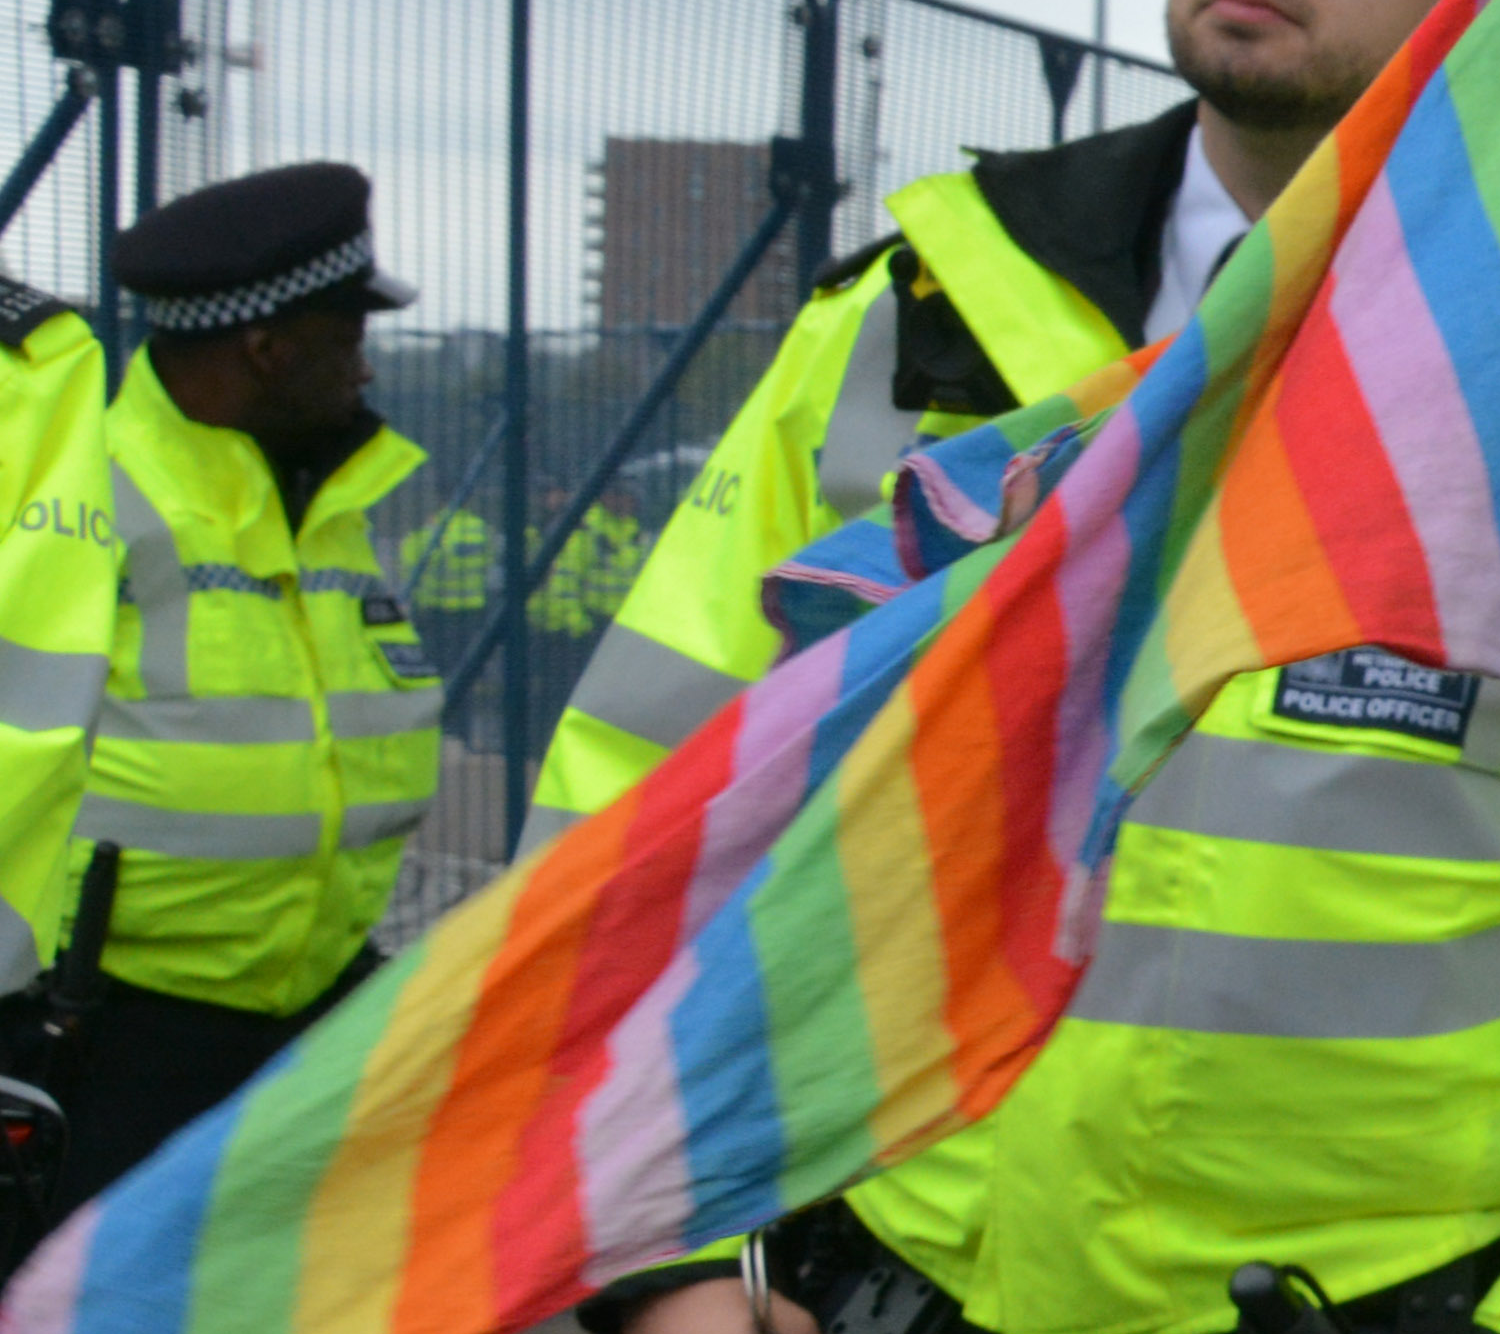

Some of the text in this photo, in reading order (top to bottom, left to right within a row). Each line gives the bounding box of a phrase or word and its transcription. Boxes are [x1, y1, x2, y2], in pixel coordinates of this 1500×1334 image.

[18, 497, 113, 548] OLIC
[1363, 667, 1440, 694] POLICE
[1282, 689, 1461, 733] POLICE OFFICER
